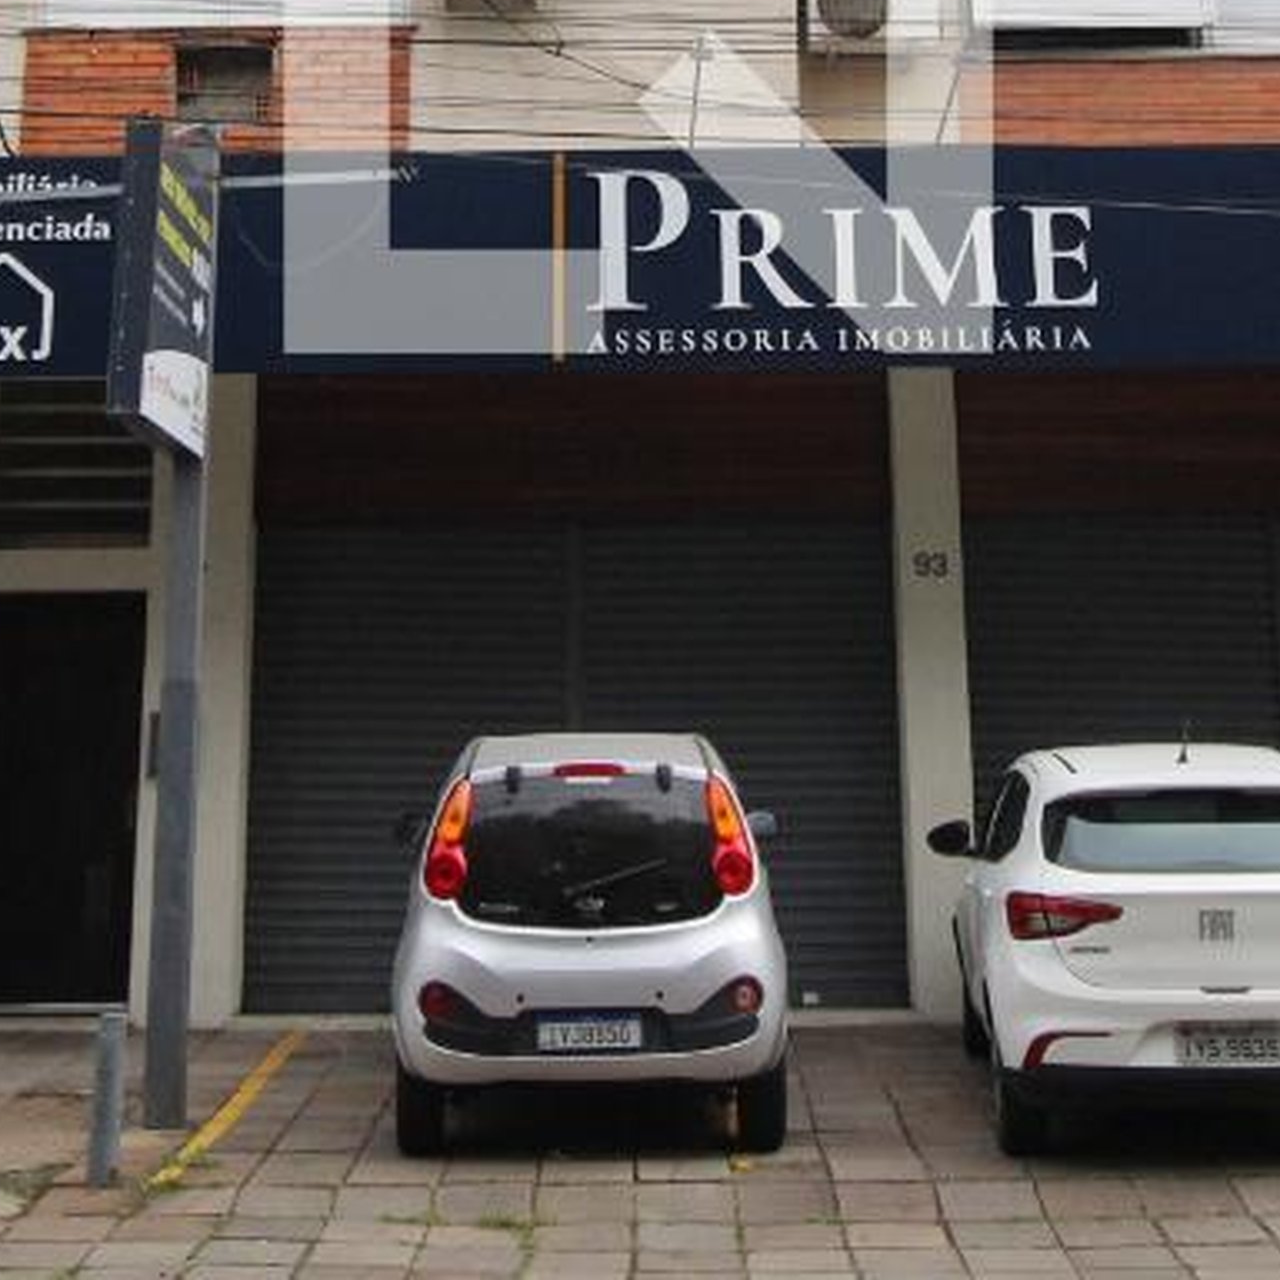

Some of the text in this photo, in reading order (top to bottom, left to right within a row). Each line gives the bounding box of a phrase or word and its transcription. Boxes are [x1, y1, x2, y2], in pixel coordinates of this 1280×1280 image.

[586, 169, 1099, 312] PRIME
[586, 320, 1092, 355] ASSESSORIA IMOBILIÁRIA
[912, 551, 948, 578] 93
